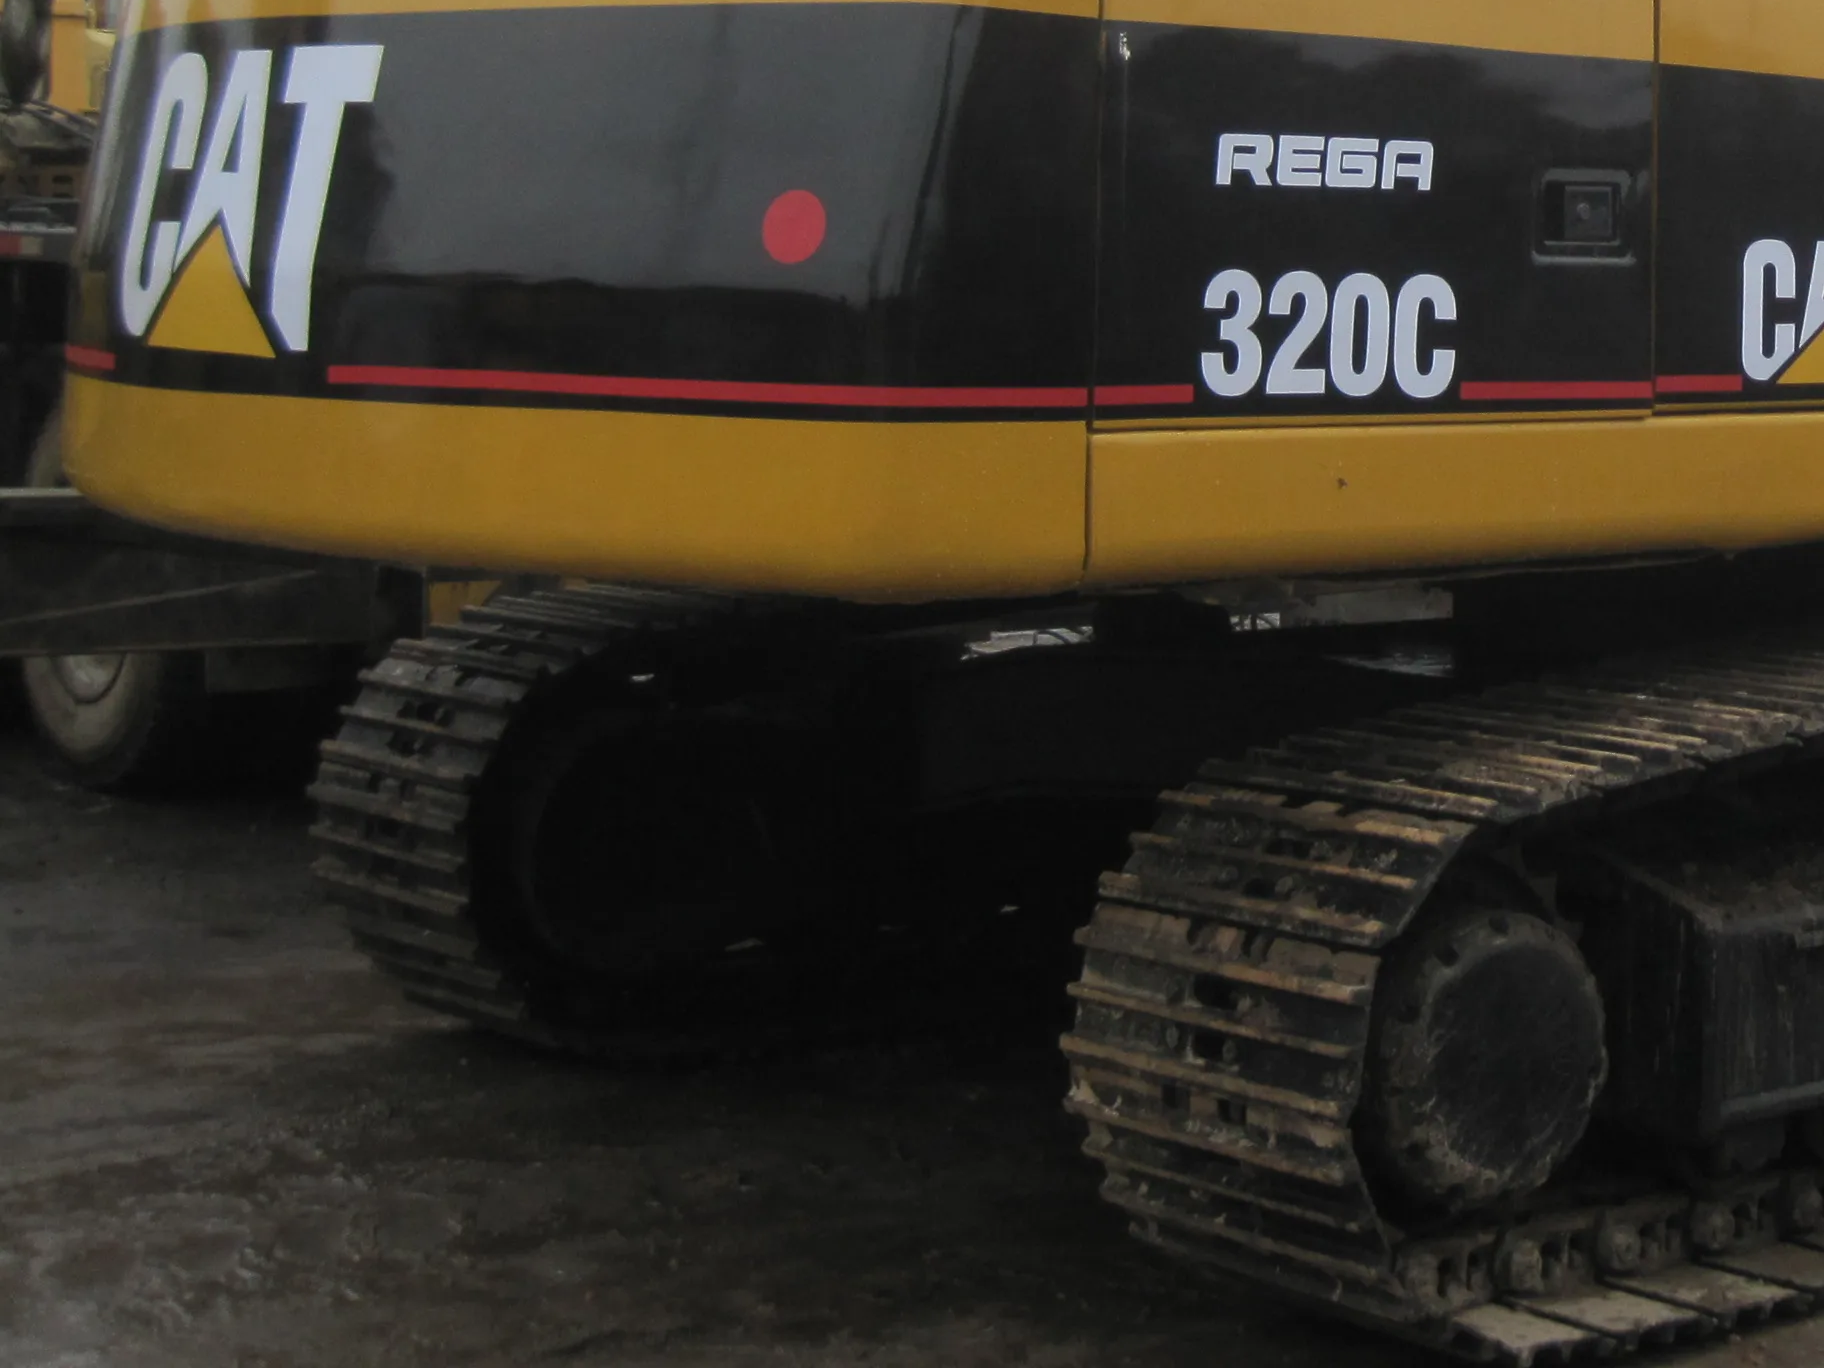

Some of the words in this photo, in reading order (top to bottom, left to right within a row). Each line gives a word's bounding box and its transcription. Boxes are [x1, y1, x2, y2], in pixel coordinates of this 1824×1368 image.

[120, 44, 384, 352] CAT
[1215, 133, 1434, 191] REGA
[1201, 268, 1457, 398] 320C
